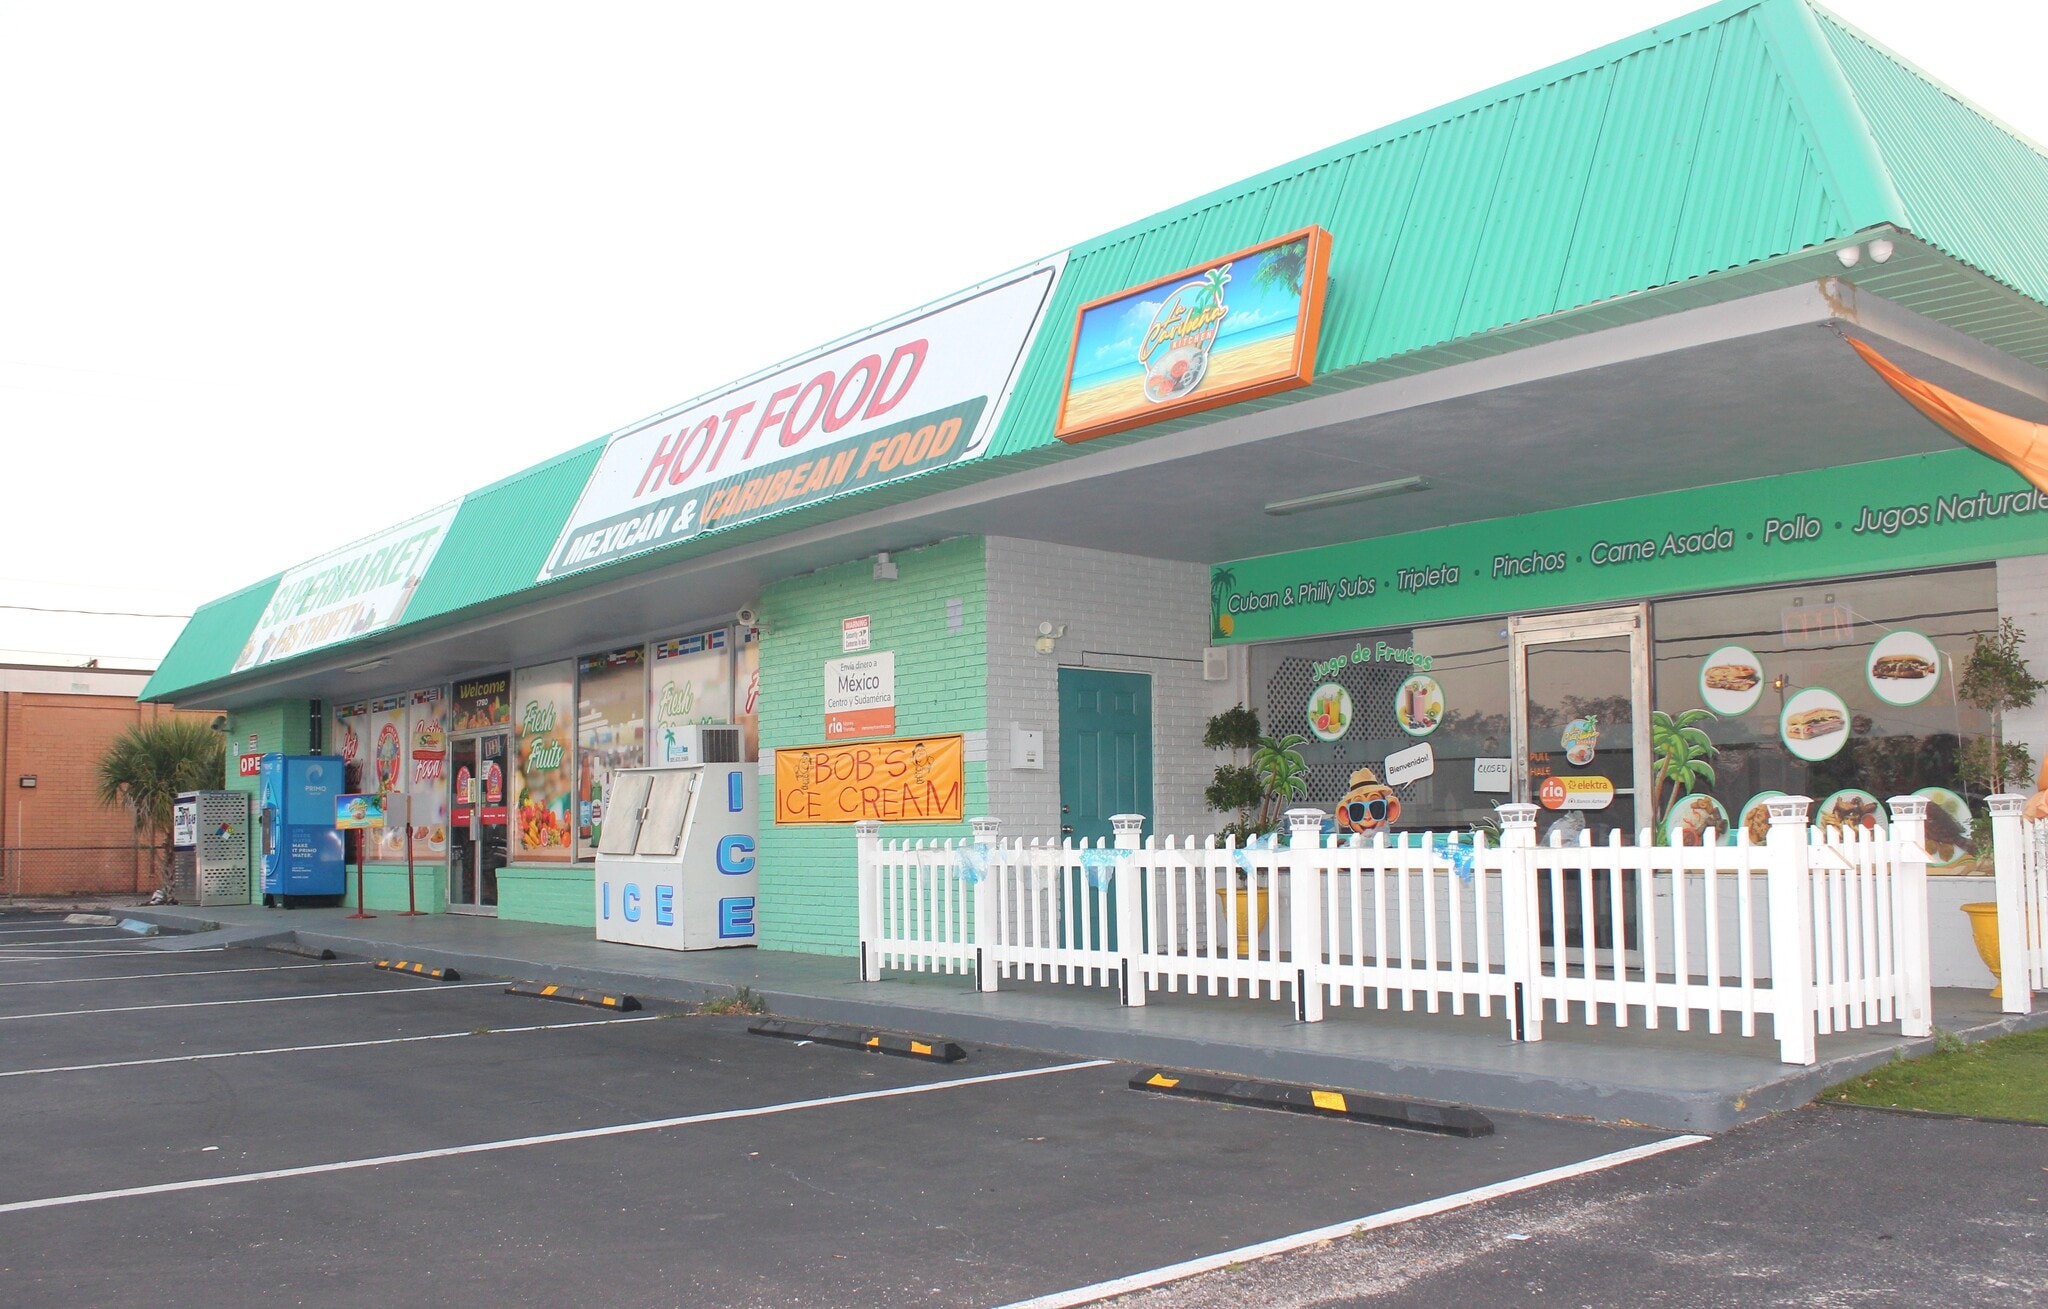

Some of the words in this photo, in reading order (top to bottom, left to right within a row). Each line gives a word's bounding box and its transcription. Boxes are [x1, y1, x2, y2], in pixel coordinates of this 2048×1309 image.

[1161, 297, 1187, 330] La
[1140, 306, 1228, 361] Caribeña
[1172, 331, 1212, 349] KITCHEN
[633, 400, 757, 499] HOT
[743, 338, 929, 461] FOOD
[562, 513, 678, 567] MEXICAN
[672, 498, 698, 530] &
[700, 449, 857, 525] CARIBEAN
[857, 417, 963, 479] FOOD
[1228, 590, 1279, 615] Cuban
[1282, 583, 1295, 606] &
[1298, 578, 1336, 604] Philly
[1338, 575, 1376, 598] Subs
[1397, 565, 1459, 594] Tripleta
[1492, 550, 1566, 579] Pinchos
[1591, 541, 1655, 565] Carne
[1660, 527, 1735, 557] Asada
[1764, 515, 1821, 544] Pollo
[1854, 503, 1929, 535] Jugos
[262, 525, 441, 629] SUPERMARKET
[297, 601, 365, 648] THRIFTY
[845, 619, 868, 630] WARNING
[855, 660, 873, 670] dinero
[1313, 655, 1348, 681] Jugo
[1351, 643, 1371, 664] de
[1376, 641, 1433, 671] Frutas
[460, 680, 506, 699] Welcome
[838, 672, 880, 694] México
[476, 698, 489, 708] 1780
[658, 680, 695, 722] Fresh
[828, 697, 848, 708] Centro
[849, 699, 853, 708] y
[854, 693, 891, 706] Sudamérica
[522, 700, 556, 738] Fresh
[828, 717, 843, 734] ria
[240, 756, 261, 774] OPE
[526, 736, 565, 774] Fruits
[815, 747, 907, 784] BOB'S
[1388, 753, 1429, 775] Bienvenidos!
[1477, 764, 1507, 773] CLOSED
[1530, 752, 1550, 762] PULL
[1530, 766, 1551, 776] HALE
[1542, 780, 1564, 797] ria
[1577, 780, 1608, 790] elektra
[779, 788, 822, 820] ICE
[838, 780, 959, 818] CREAM
[716, 771, 756, 939] ICE
[603, 882, 674, 927] ICE
